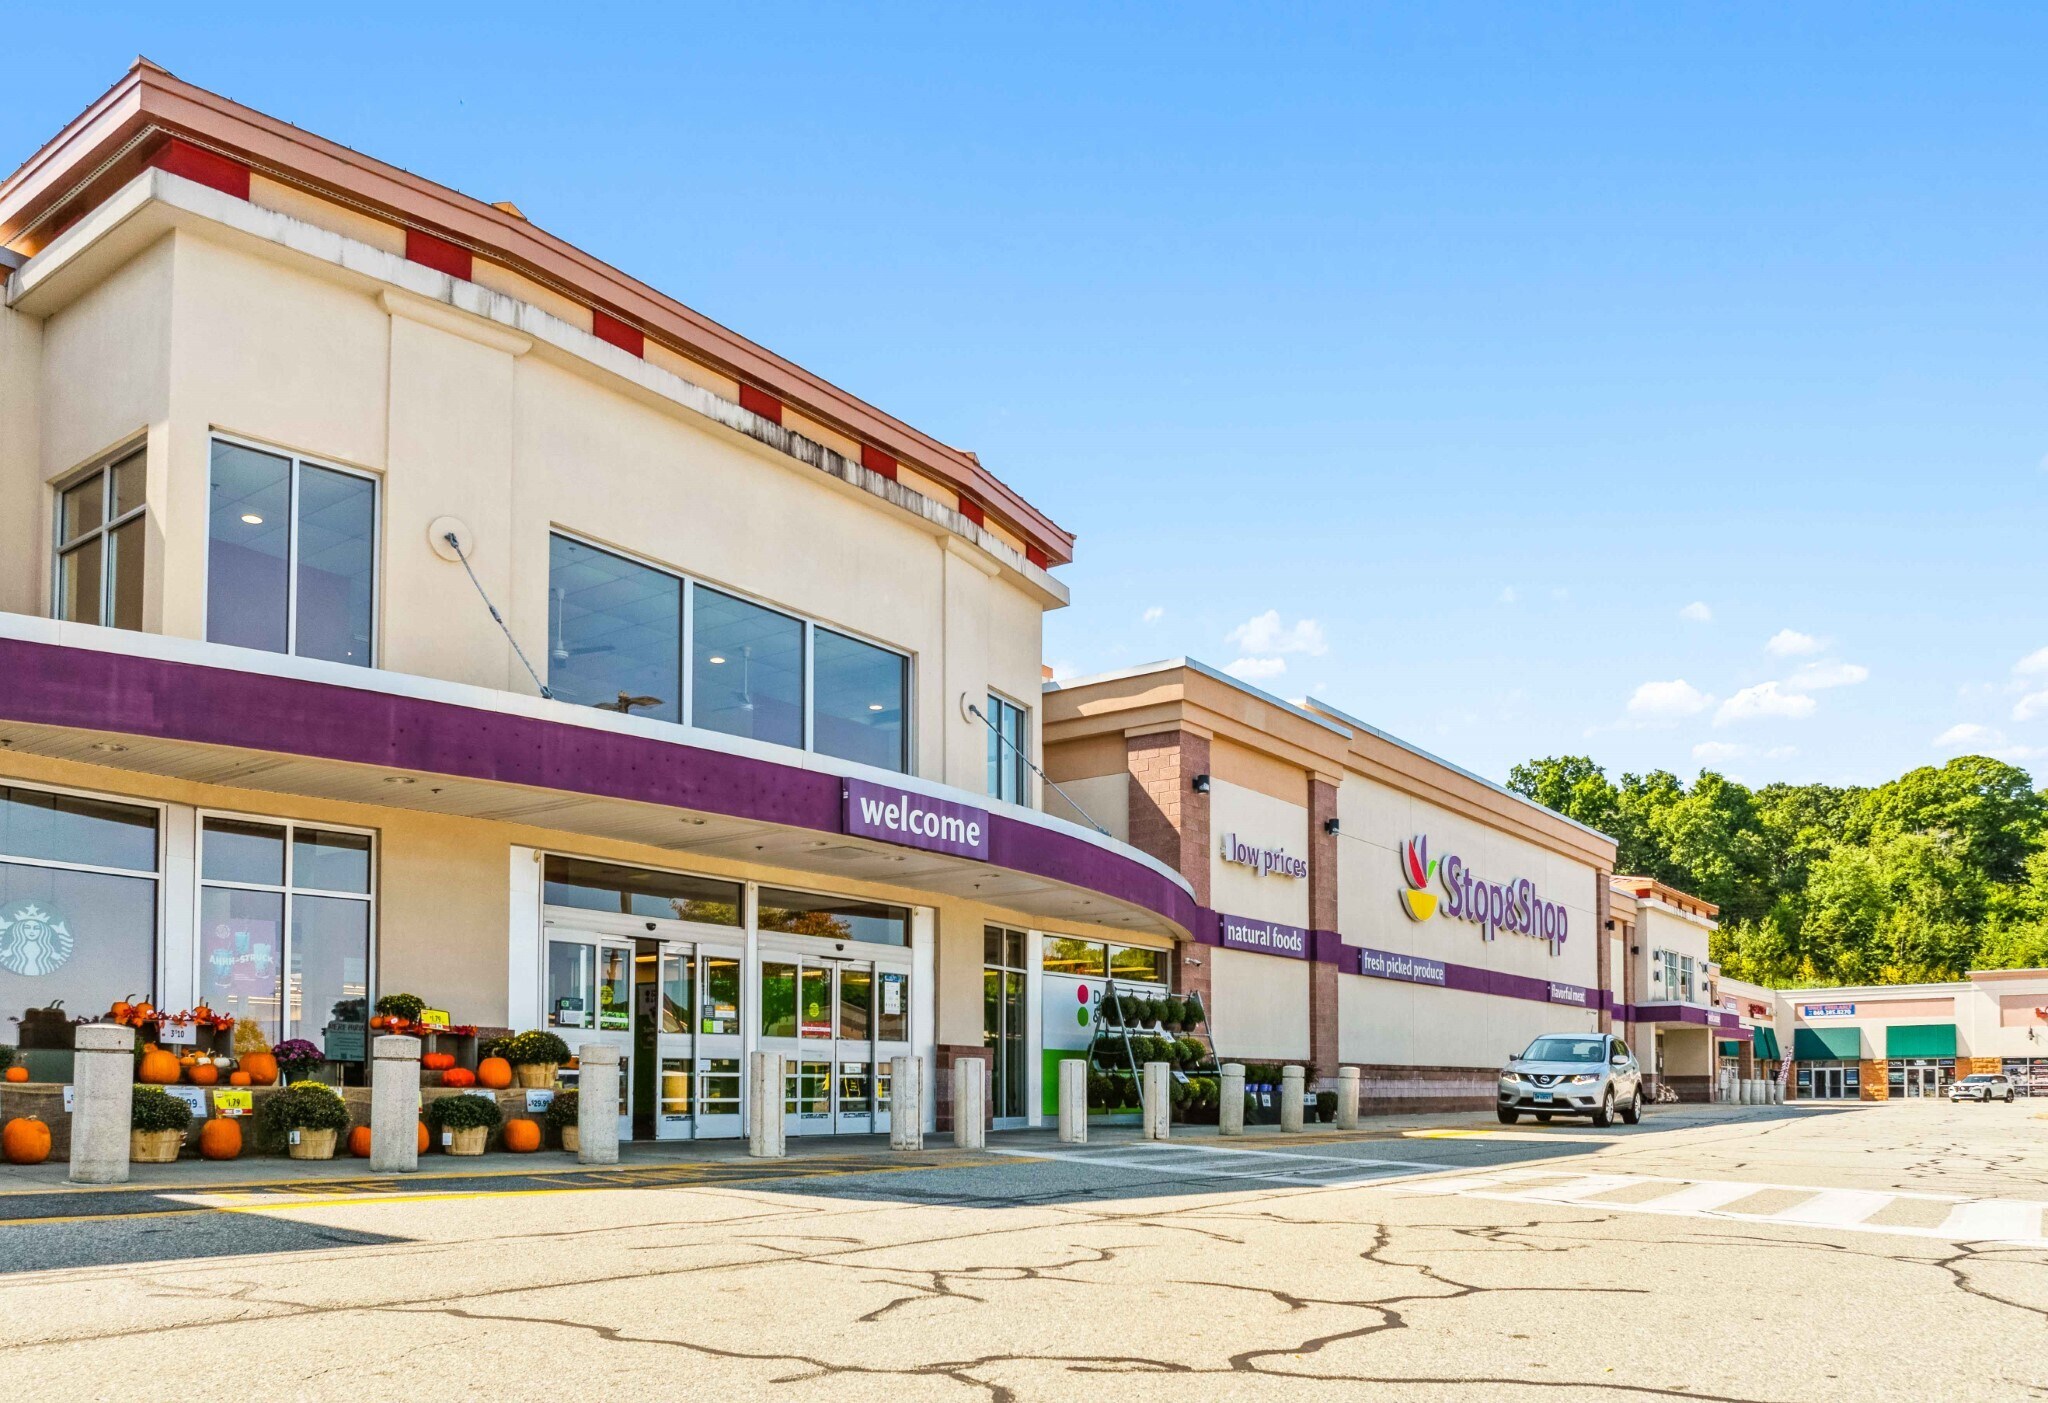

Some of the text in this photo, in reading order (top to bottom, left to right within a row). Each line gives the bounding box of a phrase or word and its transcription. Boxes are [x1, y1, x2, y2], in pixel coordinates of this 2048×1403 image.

[860, 795, 980, 846] welcome
[1230, 833, 1307, 878] low prices
[1227, 924, 1302, 951] natural foods
[1364, 951, 1444, 981] fresh picked produce
